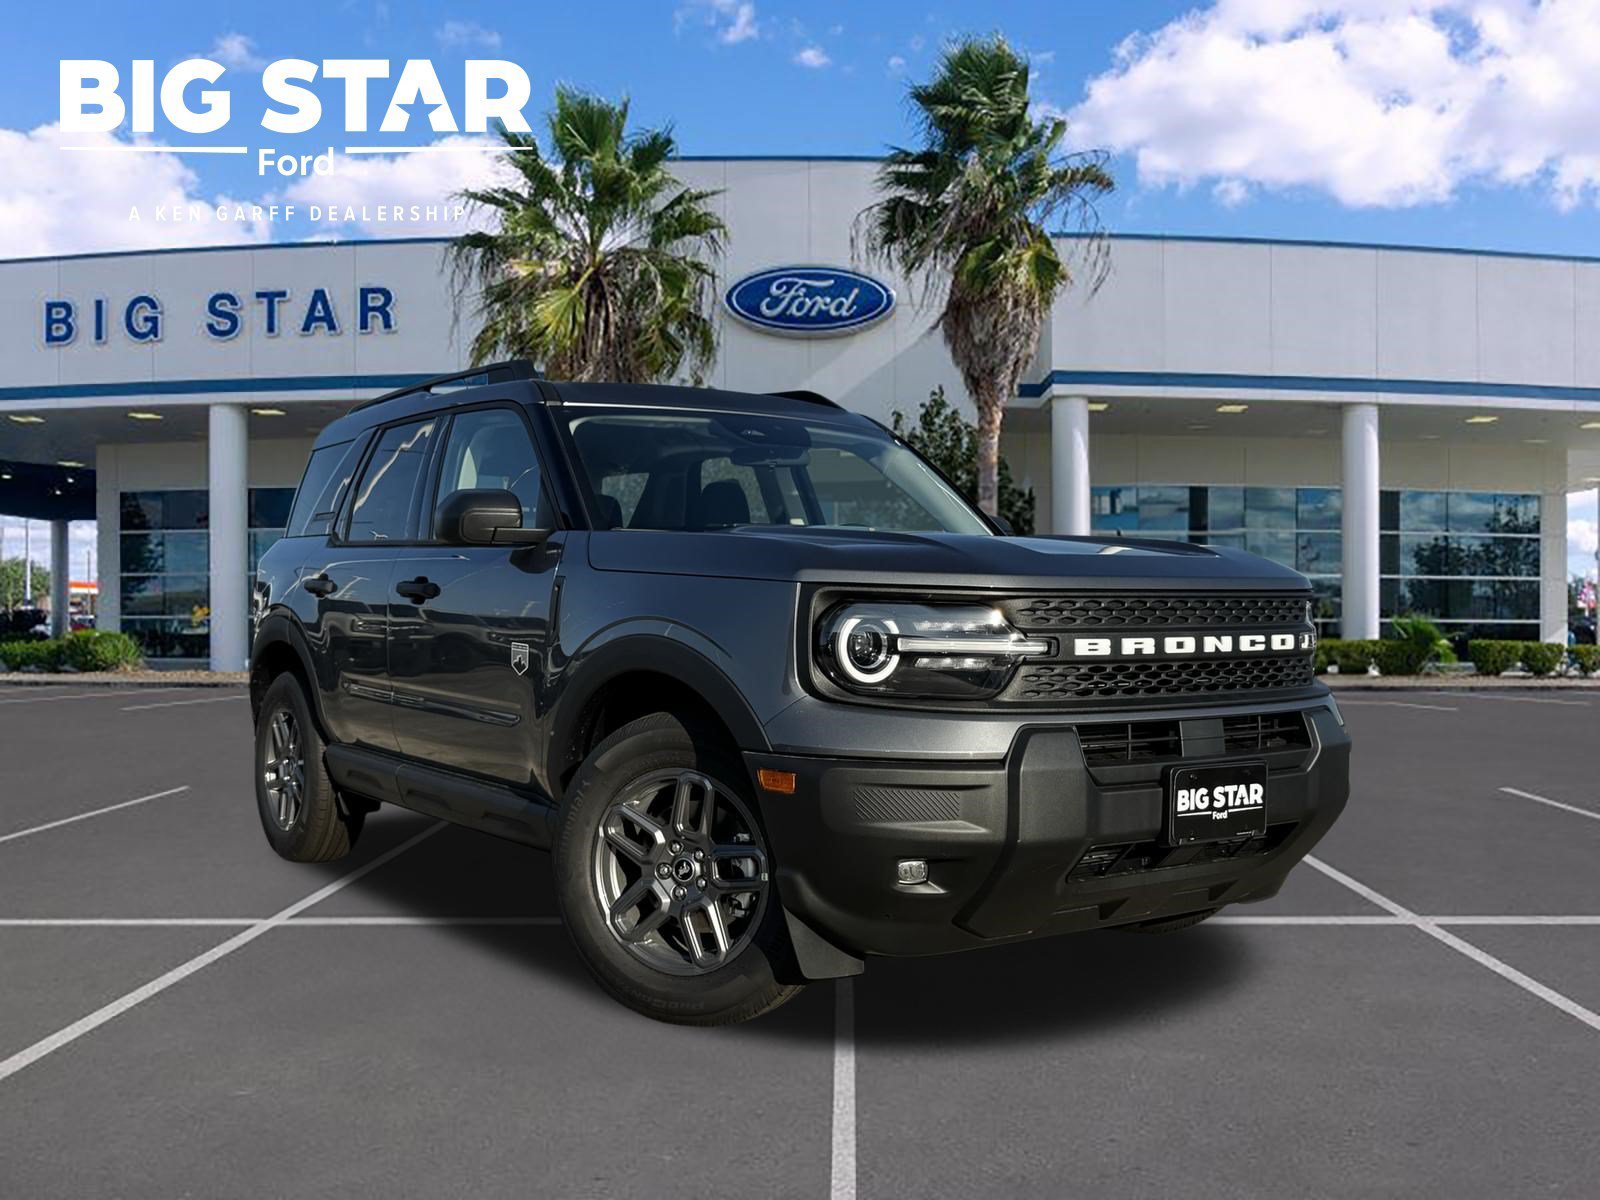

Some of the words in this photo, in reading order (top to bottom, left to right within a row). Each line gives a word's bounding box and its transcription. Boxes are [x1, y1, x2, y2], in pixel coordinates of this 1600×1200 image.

[759, 277, 860, 318] Ford
[45, 295, 163, 345] BIG
[206, 286, 397, 340] STAR
[1074, 634, 1295, 656] BRONCO
[1177, 787, 1209, 812] BIG
[1212, 783, 1264, 808] STAR
[1212, 810, 1228, 820] Ford
